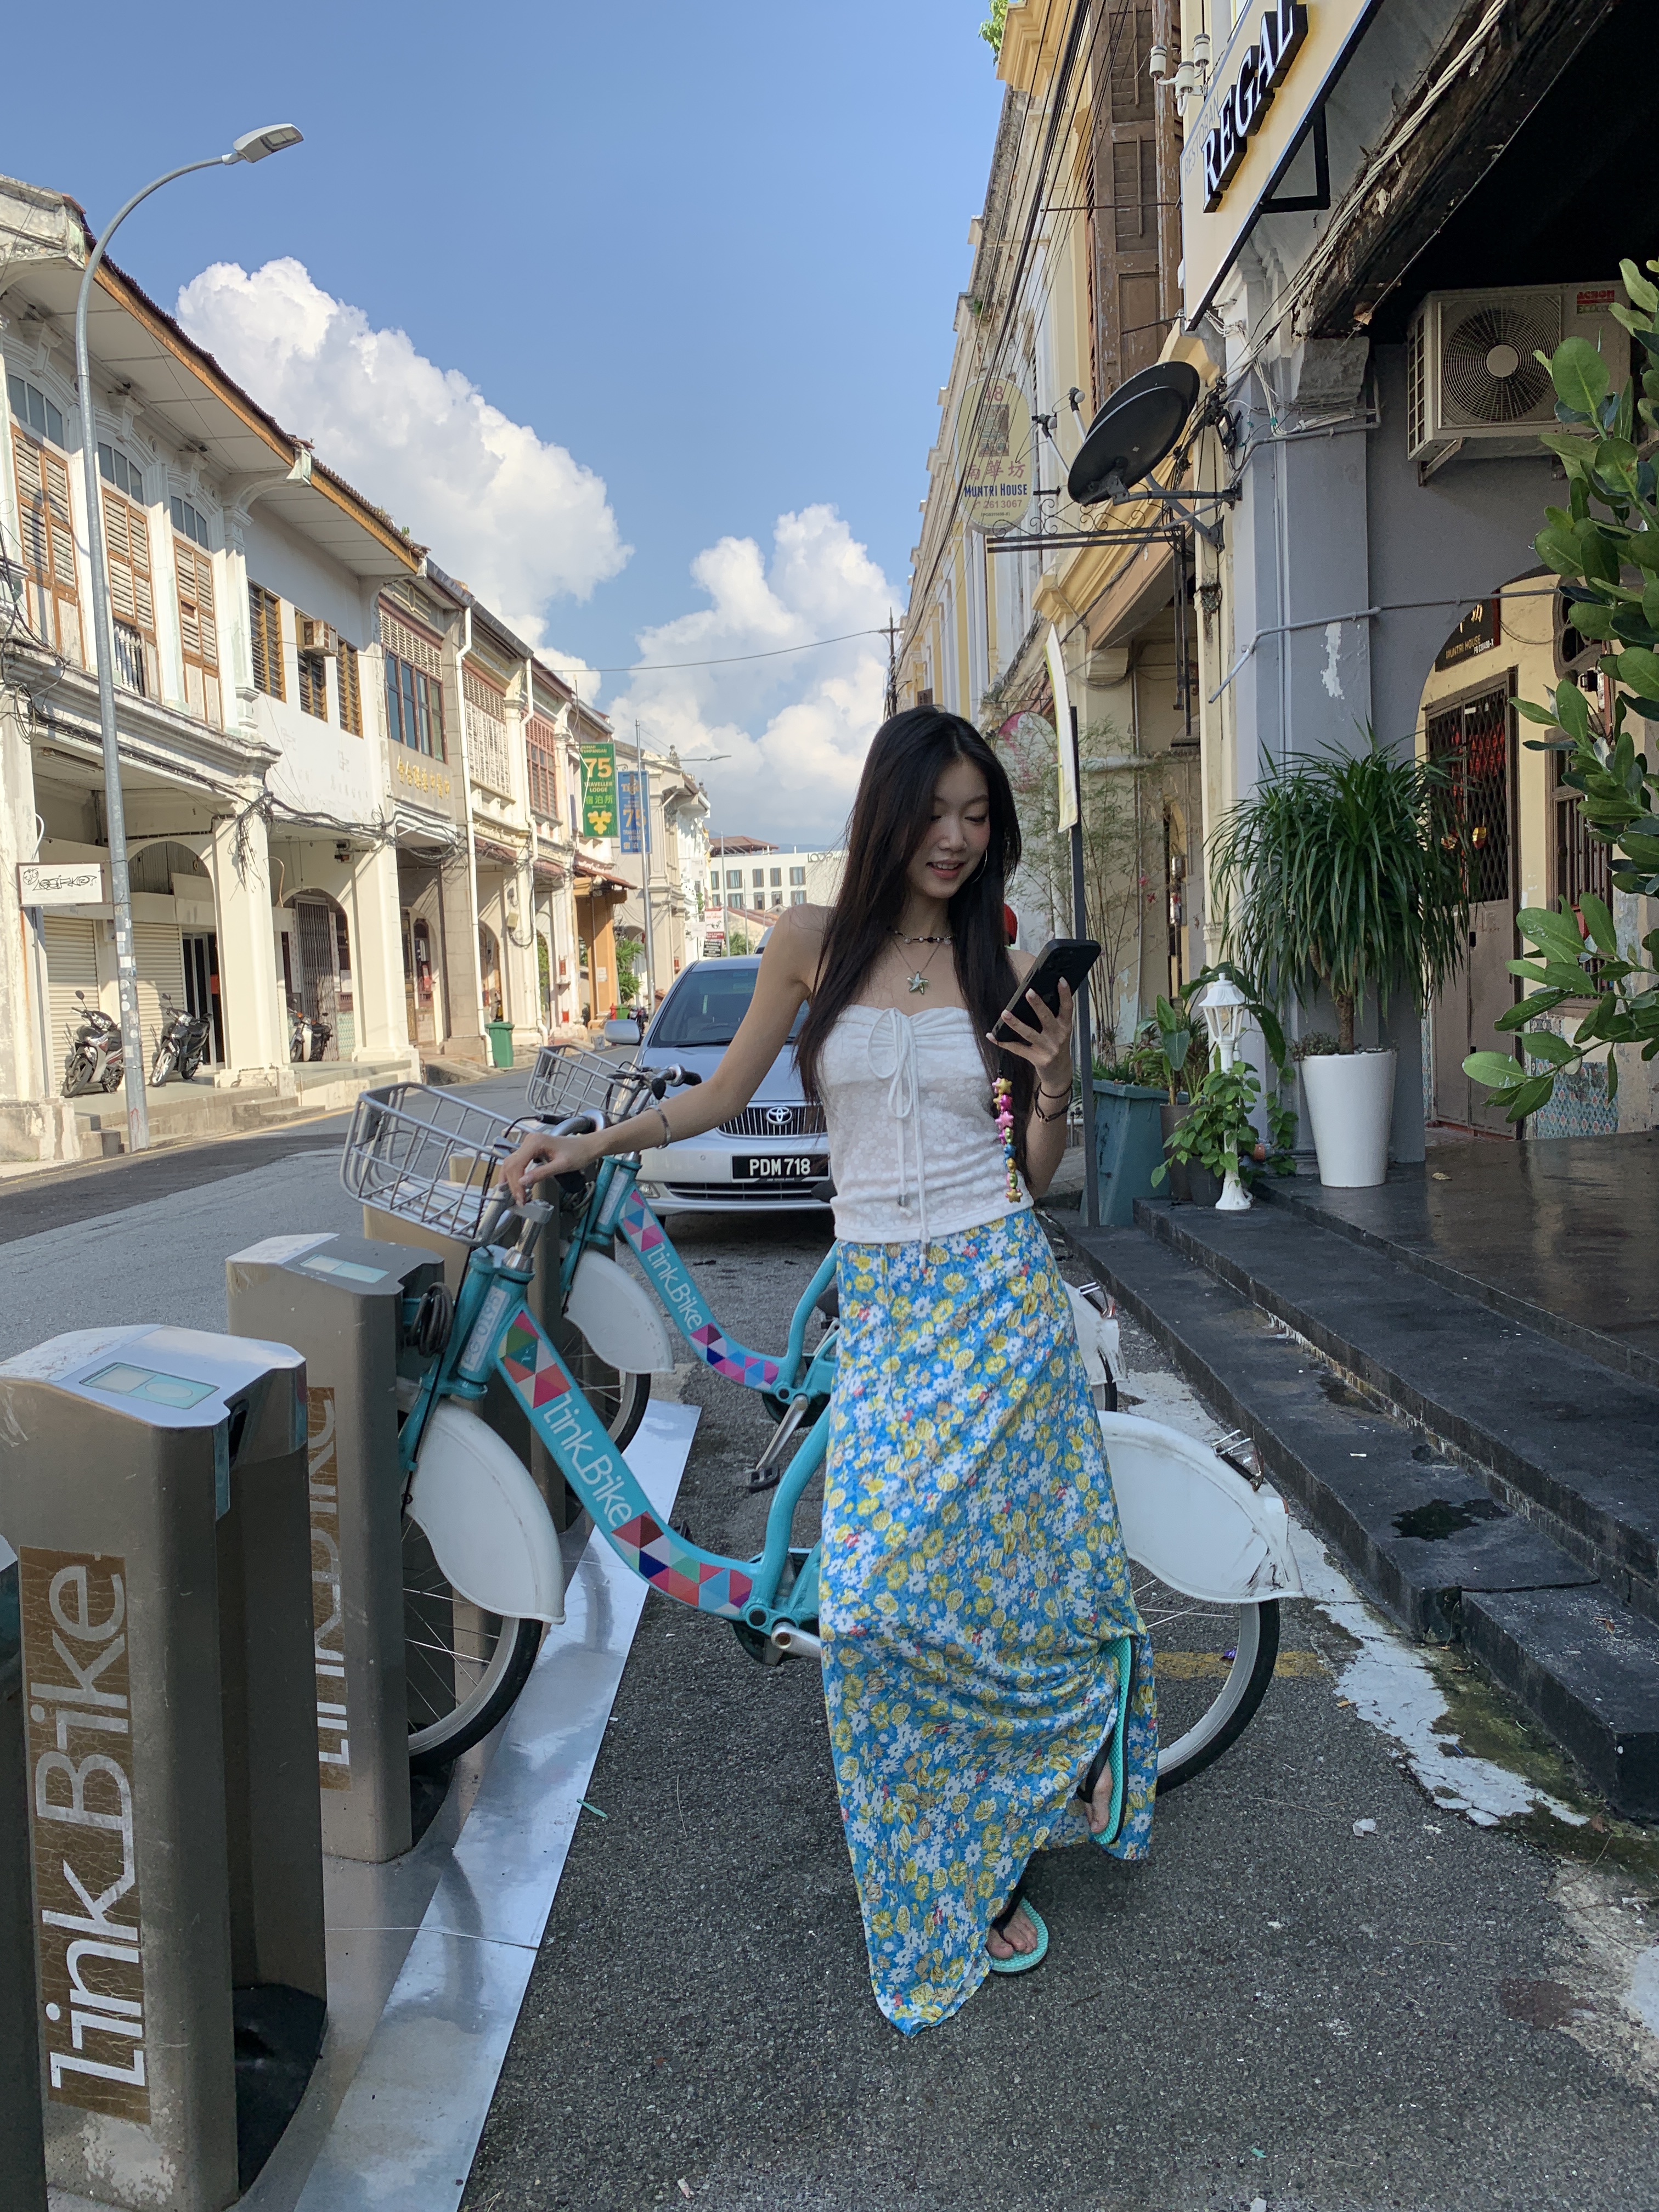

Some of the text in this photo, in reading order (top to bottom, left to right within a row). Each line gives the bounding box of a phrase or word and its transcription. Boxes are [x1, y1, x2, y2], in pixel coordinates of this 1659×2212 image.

[1201, 0, 1300, 213] REGAL
[1184, 89, 1220, 183] RESTORAN
[965, 459, 1026, 481] 南華坊
[964, 483, 1028, 498] MUNTRI HOUSE
[983, 499, 1023, 509] 261 3067
[1465, 634, 1481, 651] HOUSE
[583, 757, 612, 778] 75
[586, 795, 613, 804] 宿泊所
[623, 809, 647, 828] 75
[749, 1158, 811, 1176] PDM 718
[543, 1393, 633, 1528] LinkBike
[30, 1564, 147, 2089] LinkBike
